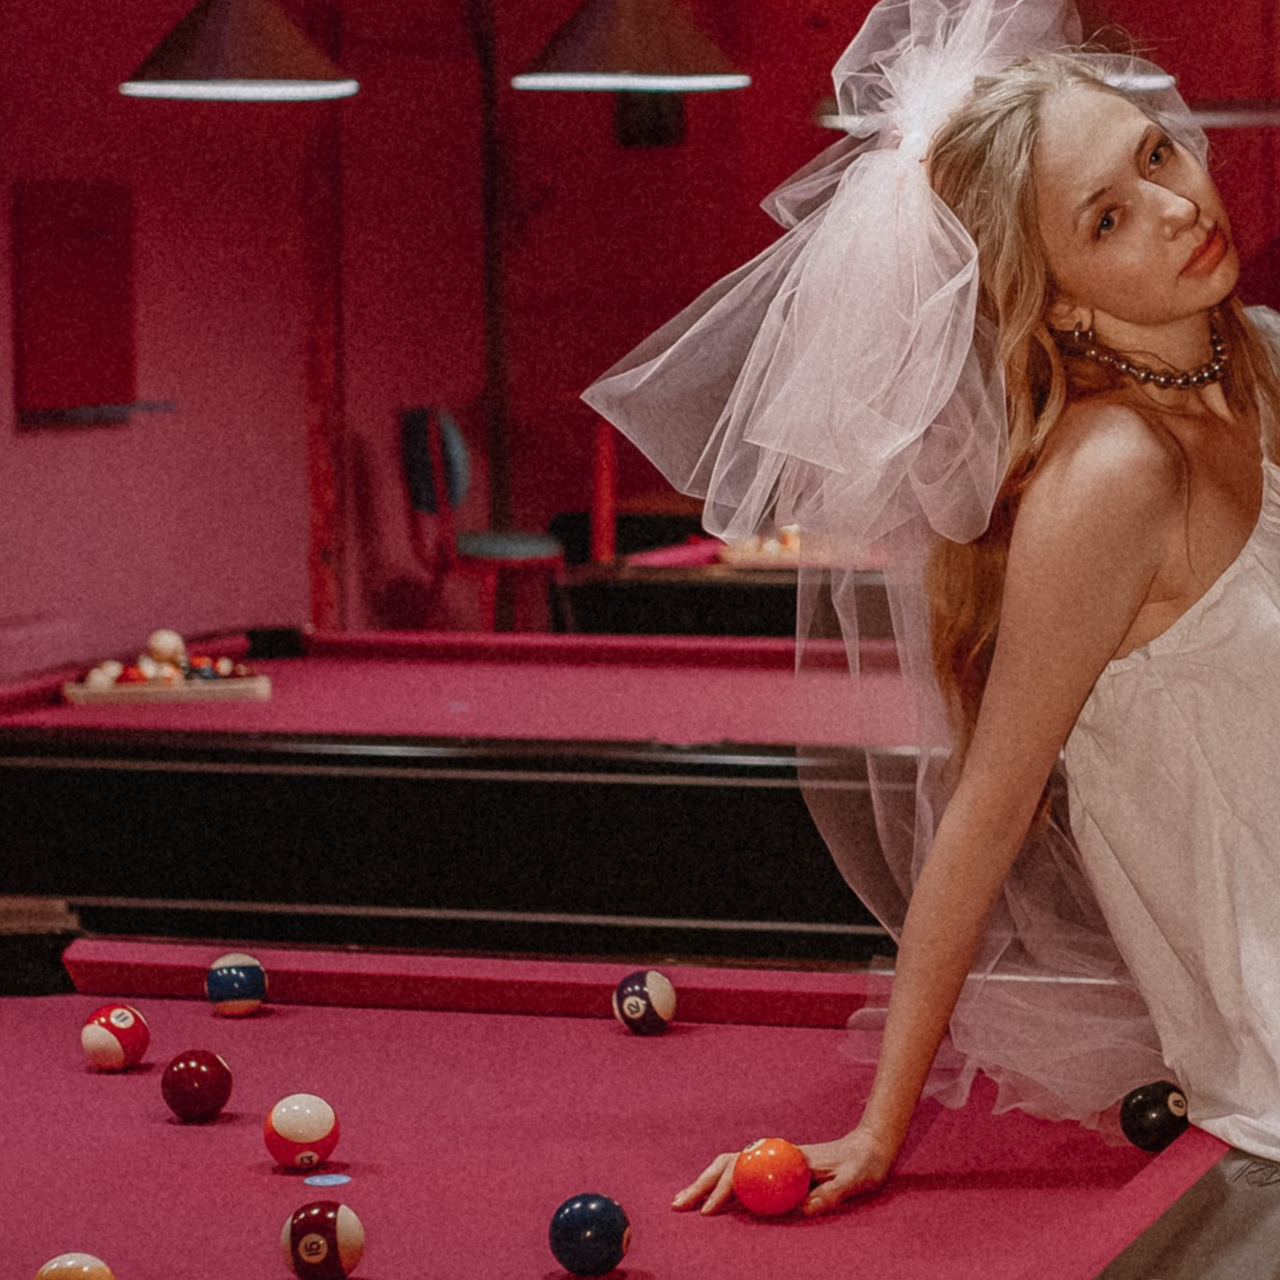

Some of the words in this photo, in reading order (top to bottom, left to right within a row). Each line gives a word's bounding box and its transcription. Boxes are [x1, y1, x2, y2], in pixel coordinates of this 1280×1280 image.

[627, 1000, 640, 1015] 12
[114, 1011, 129, 1023] 11
[1173, 1100, 1184, 1108] 8
[304, 1241, 321, 1256] 15
